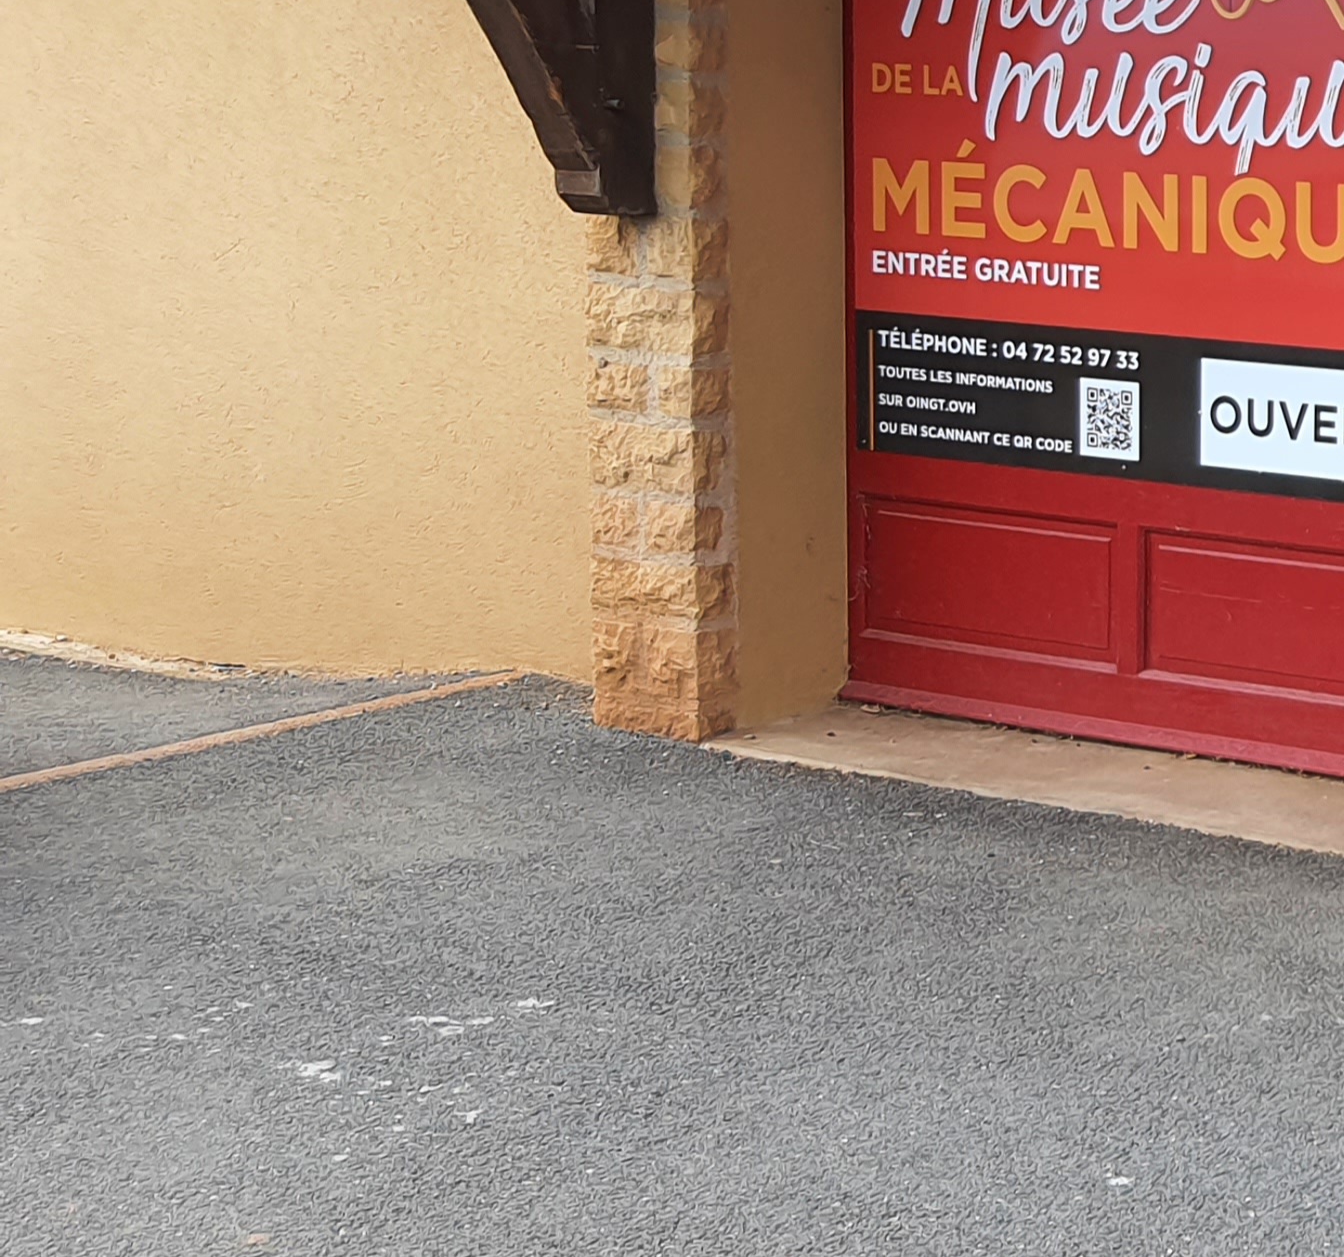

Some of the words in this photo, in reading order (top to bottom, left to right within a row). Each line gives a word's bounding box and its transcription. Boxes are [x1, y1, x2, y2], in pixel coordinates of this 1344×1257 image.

[871, 62, 912, 95] DE
[922, 64, 964, 97] LA
[871, 247, 968, 281] ENTRÉE
[974, 257, 1101, 290] GRATUITE
[877, 326, 988, 357] TÉLÉPHONE
[1002, 341, 1028, 360] 04
[1032, 343, 1055, 363] 72
[1059, 346, 1083, 365] 52
[1087, 348, 1111, 367] 97
[1115, 350, 1140, 370] 33
[877, 364, 928, 382] TOUTES
[930, 369, 952, 384] LES
[955, 371, 1054, 393] INFORMATIONS
[877, 393, 903, 408] SUR
[906, 395, 977, 415] OINGT.OVH
[878, 421, 898, 435] OU
[900, 423, 918, 437] EN
[920, 425, 990, 445] SCANNANT
[993, 432, 1011, 447] CE
[1013, 434, 1033, 451] QR
[1034, 436, 1073, 454] CODE
